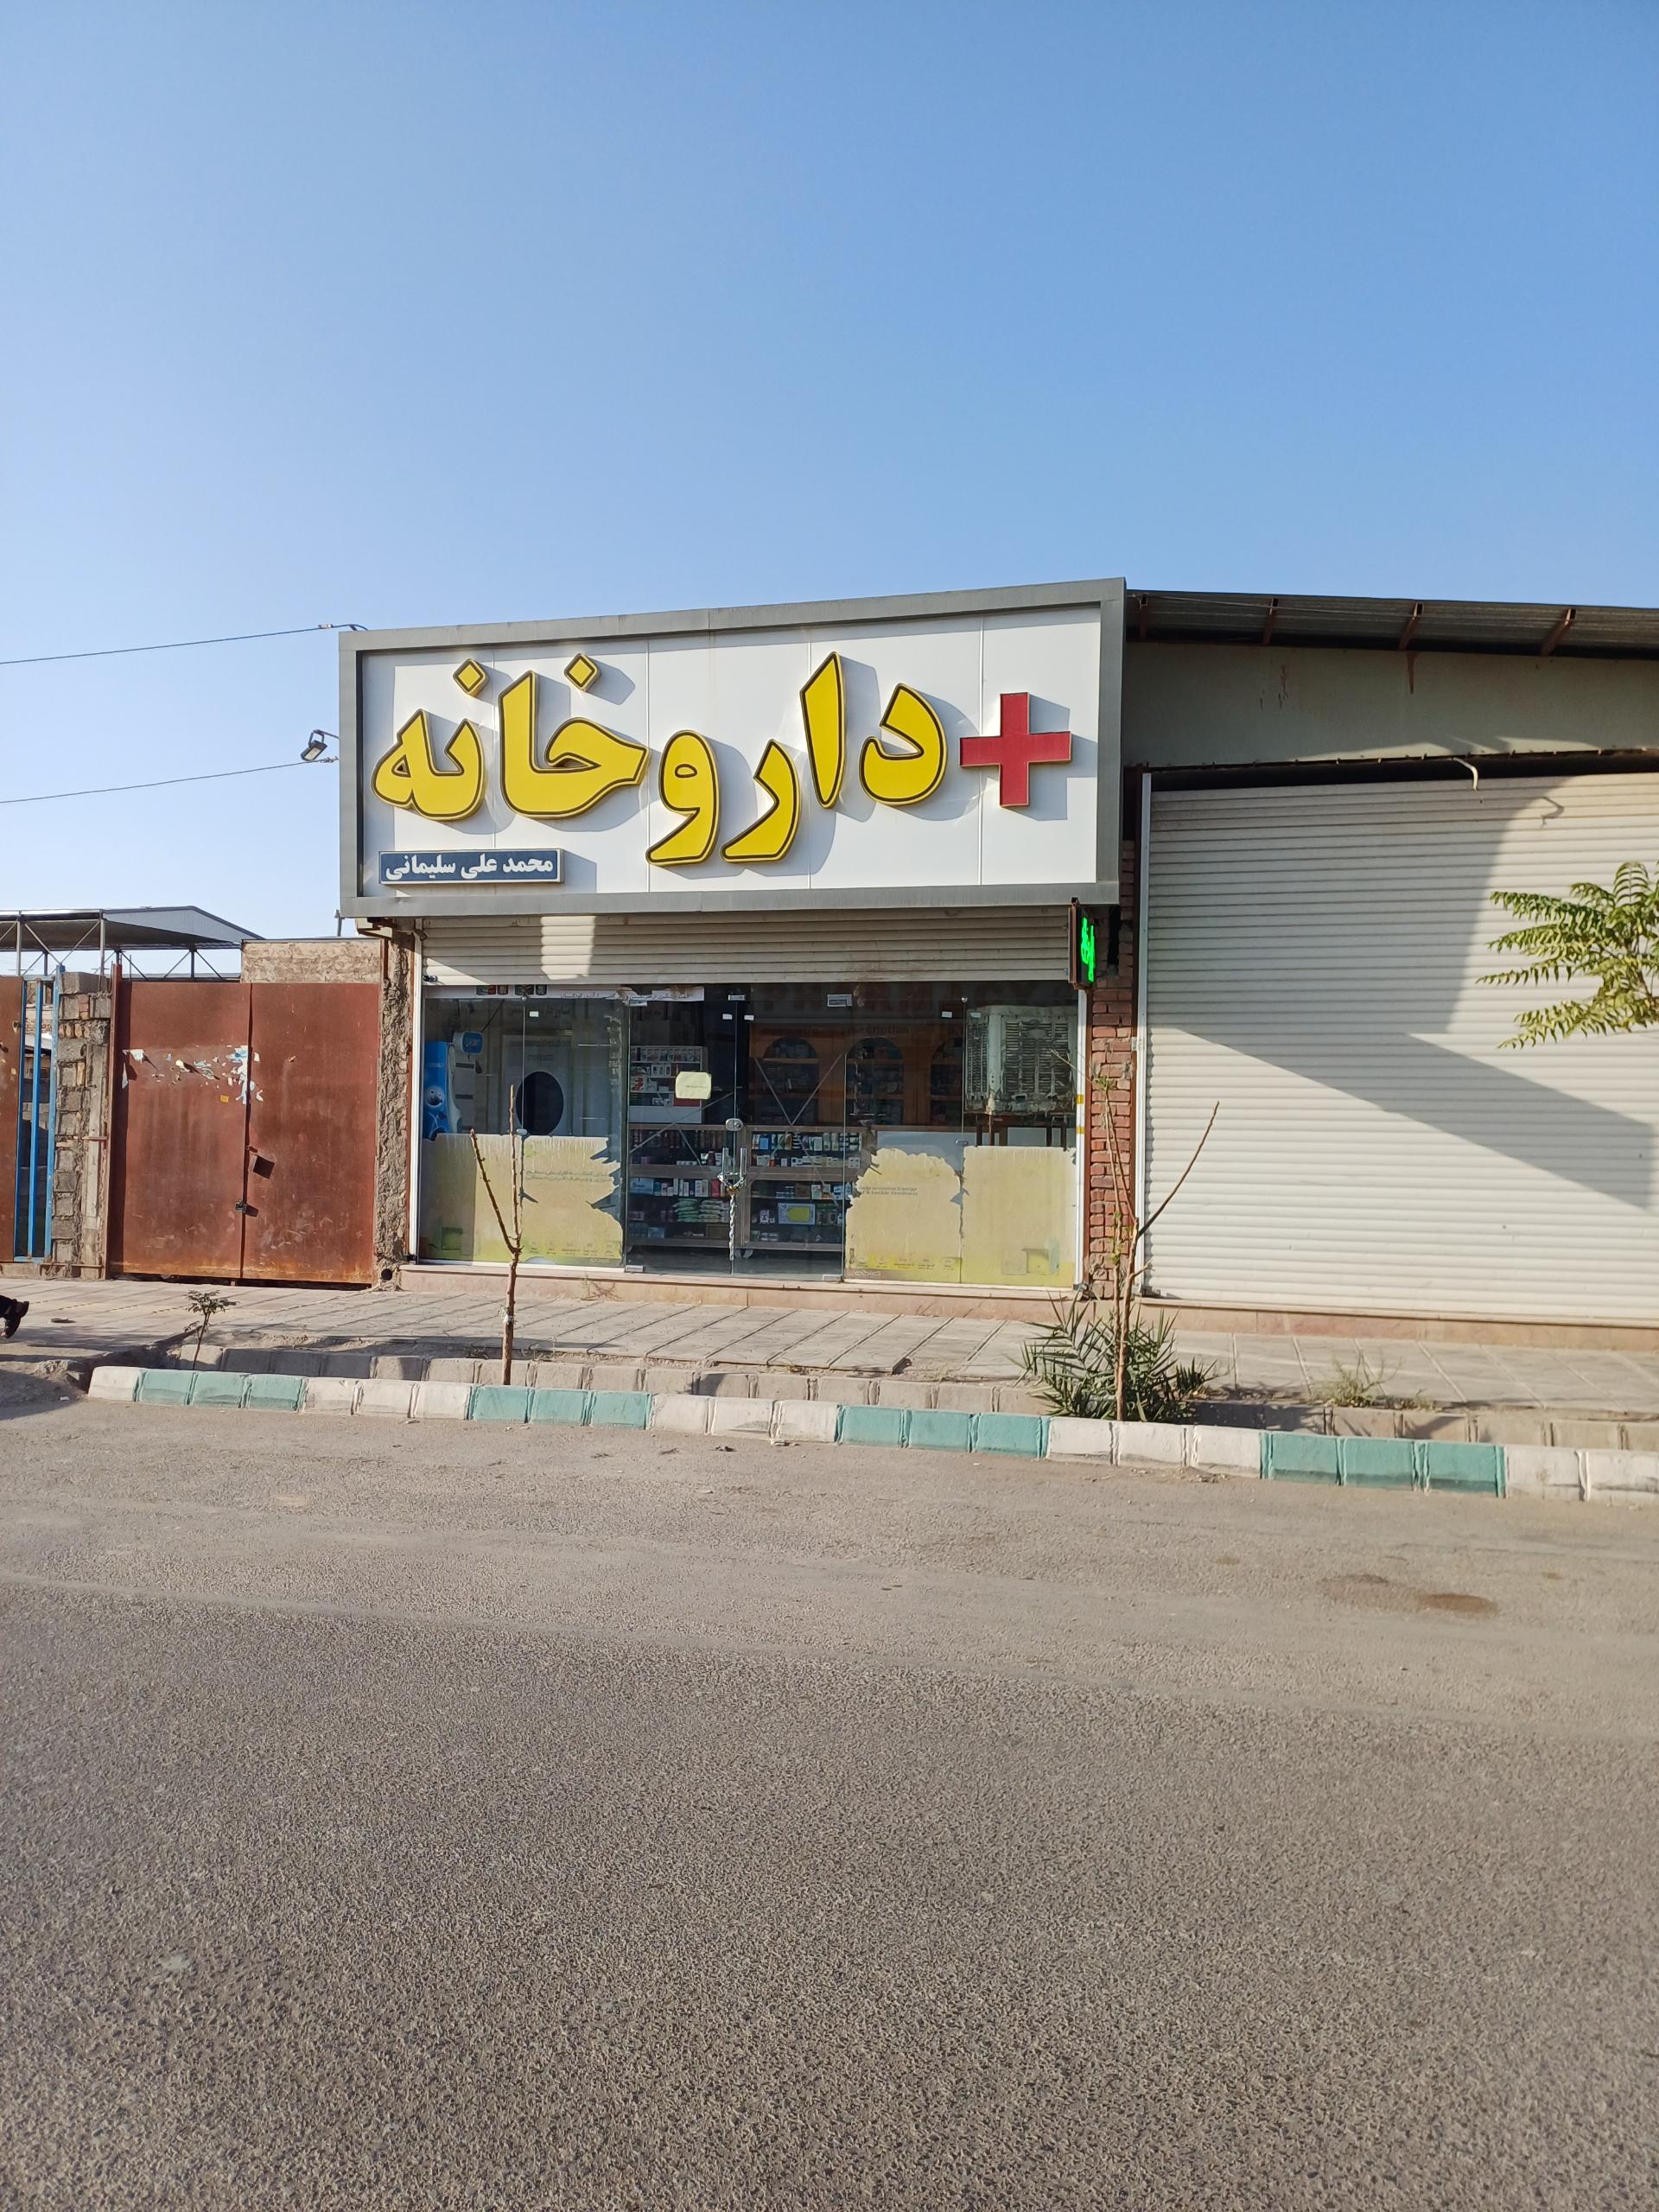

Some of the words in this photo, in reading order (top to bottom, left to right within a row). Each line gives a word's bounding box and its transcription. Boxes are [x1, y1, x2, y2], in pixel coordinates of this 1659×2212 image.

[371, 650, 948, 866] داروخانه
[385, 855, 456, 880] سلیمانی
[461, 854, 498, 879] علی
[502, 857, 554, 873] محمد
